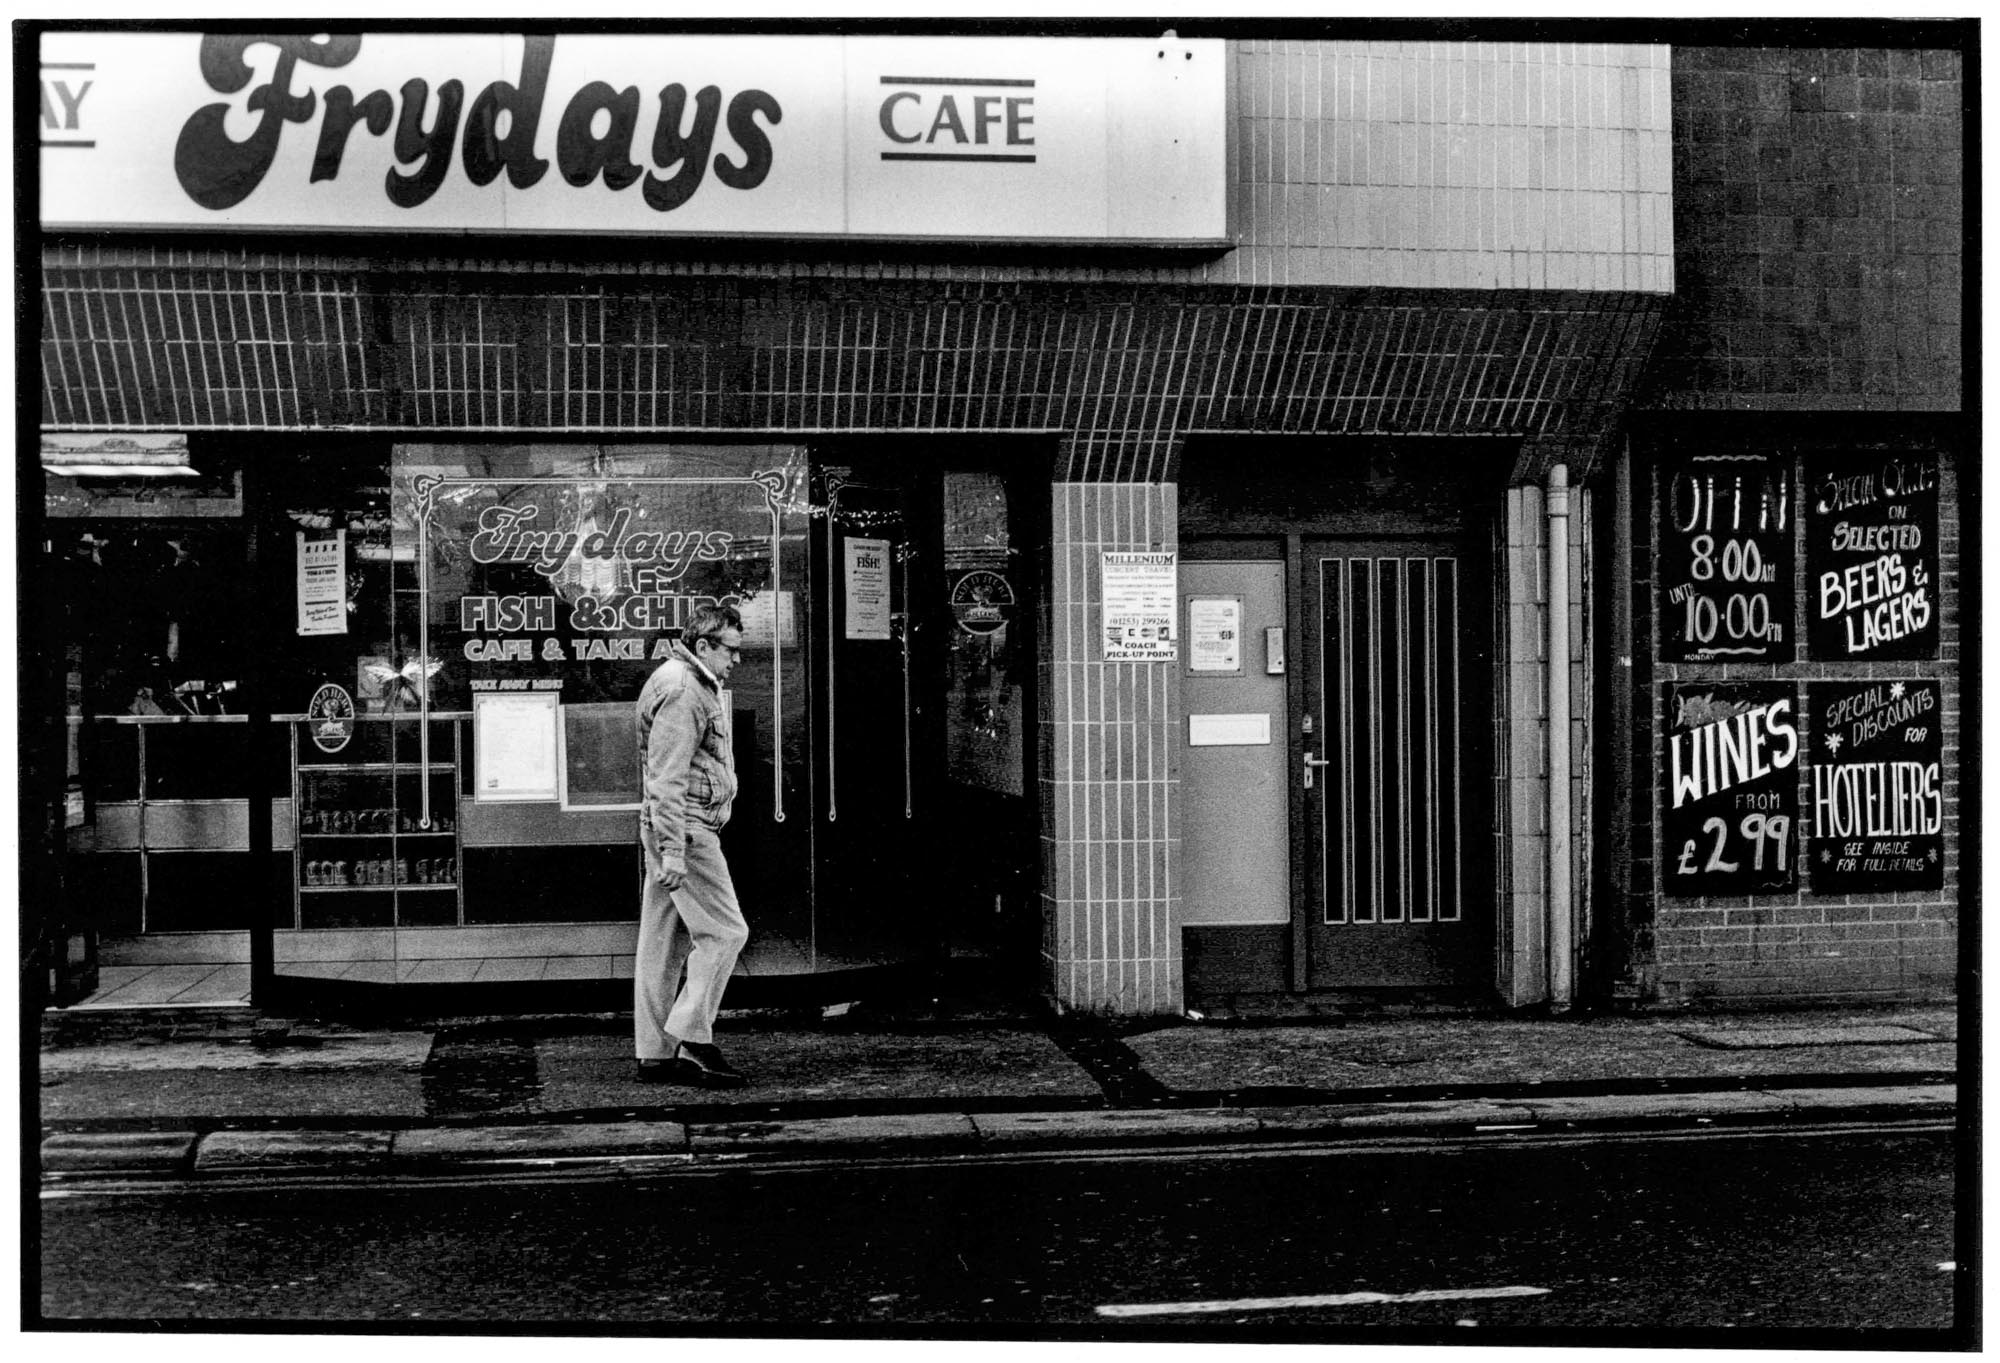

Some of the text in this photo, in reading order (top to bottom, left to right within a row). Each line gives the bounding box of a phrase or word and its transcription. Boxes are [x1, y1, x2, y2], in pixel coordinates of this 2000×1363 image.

[175, 34, 782, 211] Frydays
[879, 91, 1035, 146] CAFE
[1888, 505, 1907, 519] ON
[470, 505, 733, 580] Frydays
[1831, 521, 1921, 551] SELECTED
[857, 557, 880, 569] FISH!
[1104, 554, 1175, 565] MILLENIUM
[1820, 553, 1928, 619] BEERS &
[461, 595, 555, 631] FISH
[623, 595, 742, 630] CHI
[1846, 588, 1931, 652] LAGERS
[463, 638, 533, 662] CAFE
[541, 638, 567, 661] &
[571, 638, 645, 660] TAKE
[499, 679, 530, 690] AWAY
[1826, 685, 1890, 728] SPECIAL
[1852, 688, 1934, 747] DISCOUNTS
[1905, 727, 1928, 743] FOR
[1671, 699, 1797, 810] WINES
[1735, 791, 1780, 810] FROM
[1813, 762, 1941, 838] HOTELIERS
[1836, 858, 1857, 872] FOR
[1863, 858, 1886, 872] FULL
[1844, 841, 1911, 856] SEE INSIDE
